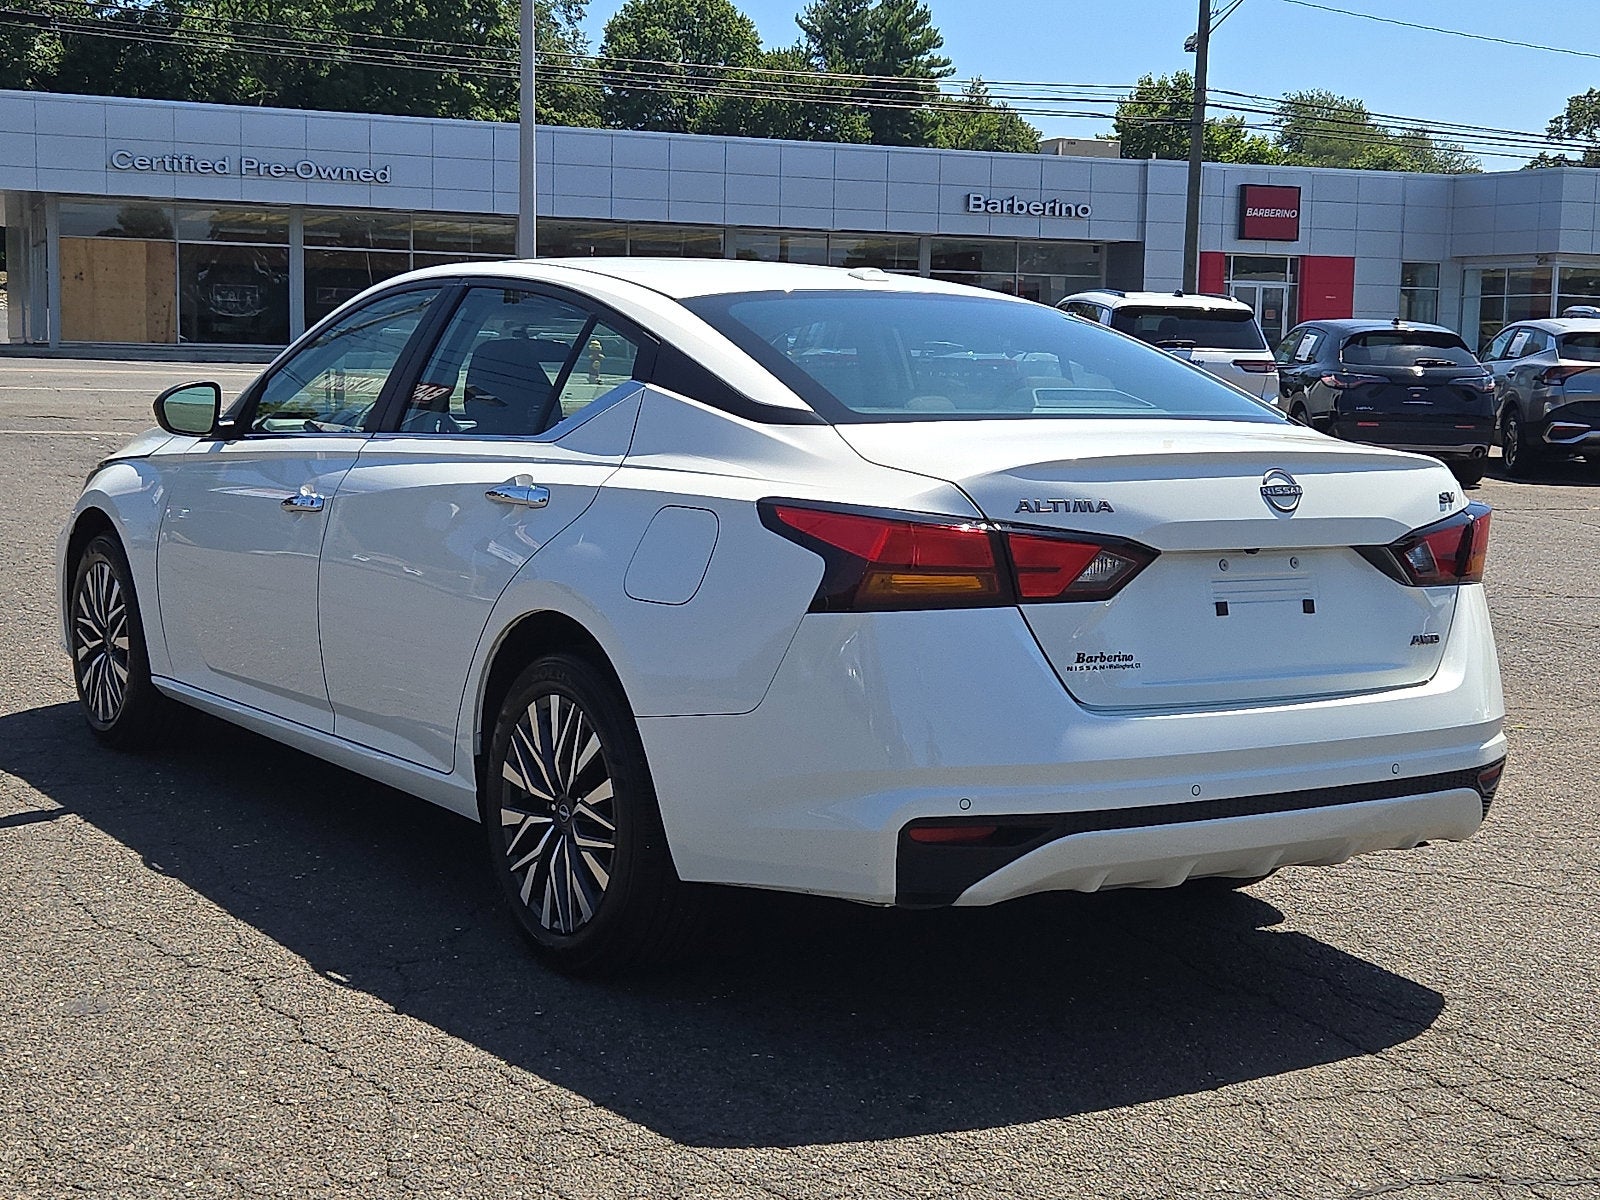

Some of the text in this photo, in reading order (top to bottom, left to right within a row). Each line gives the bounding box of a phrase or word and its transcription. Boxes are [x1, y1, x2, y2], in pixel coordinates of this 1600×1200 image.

[111, 150, 392, 184] Certified Pre-Owned
[967, 193, 1092, 218] Barberino
[1246, 208, 1298, 219] BARBERINO
[1261, 486, 1303, 496] NISSAN
[1014, 498, 1114, 513] ALTIMA
[1075, 651, 1134, 664] Barberino
